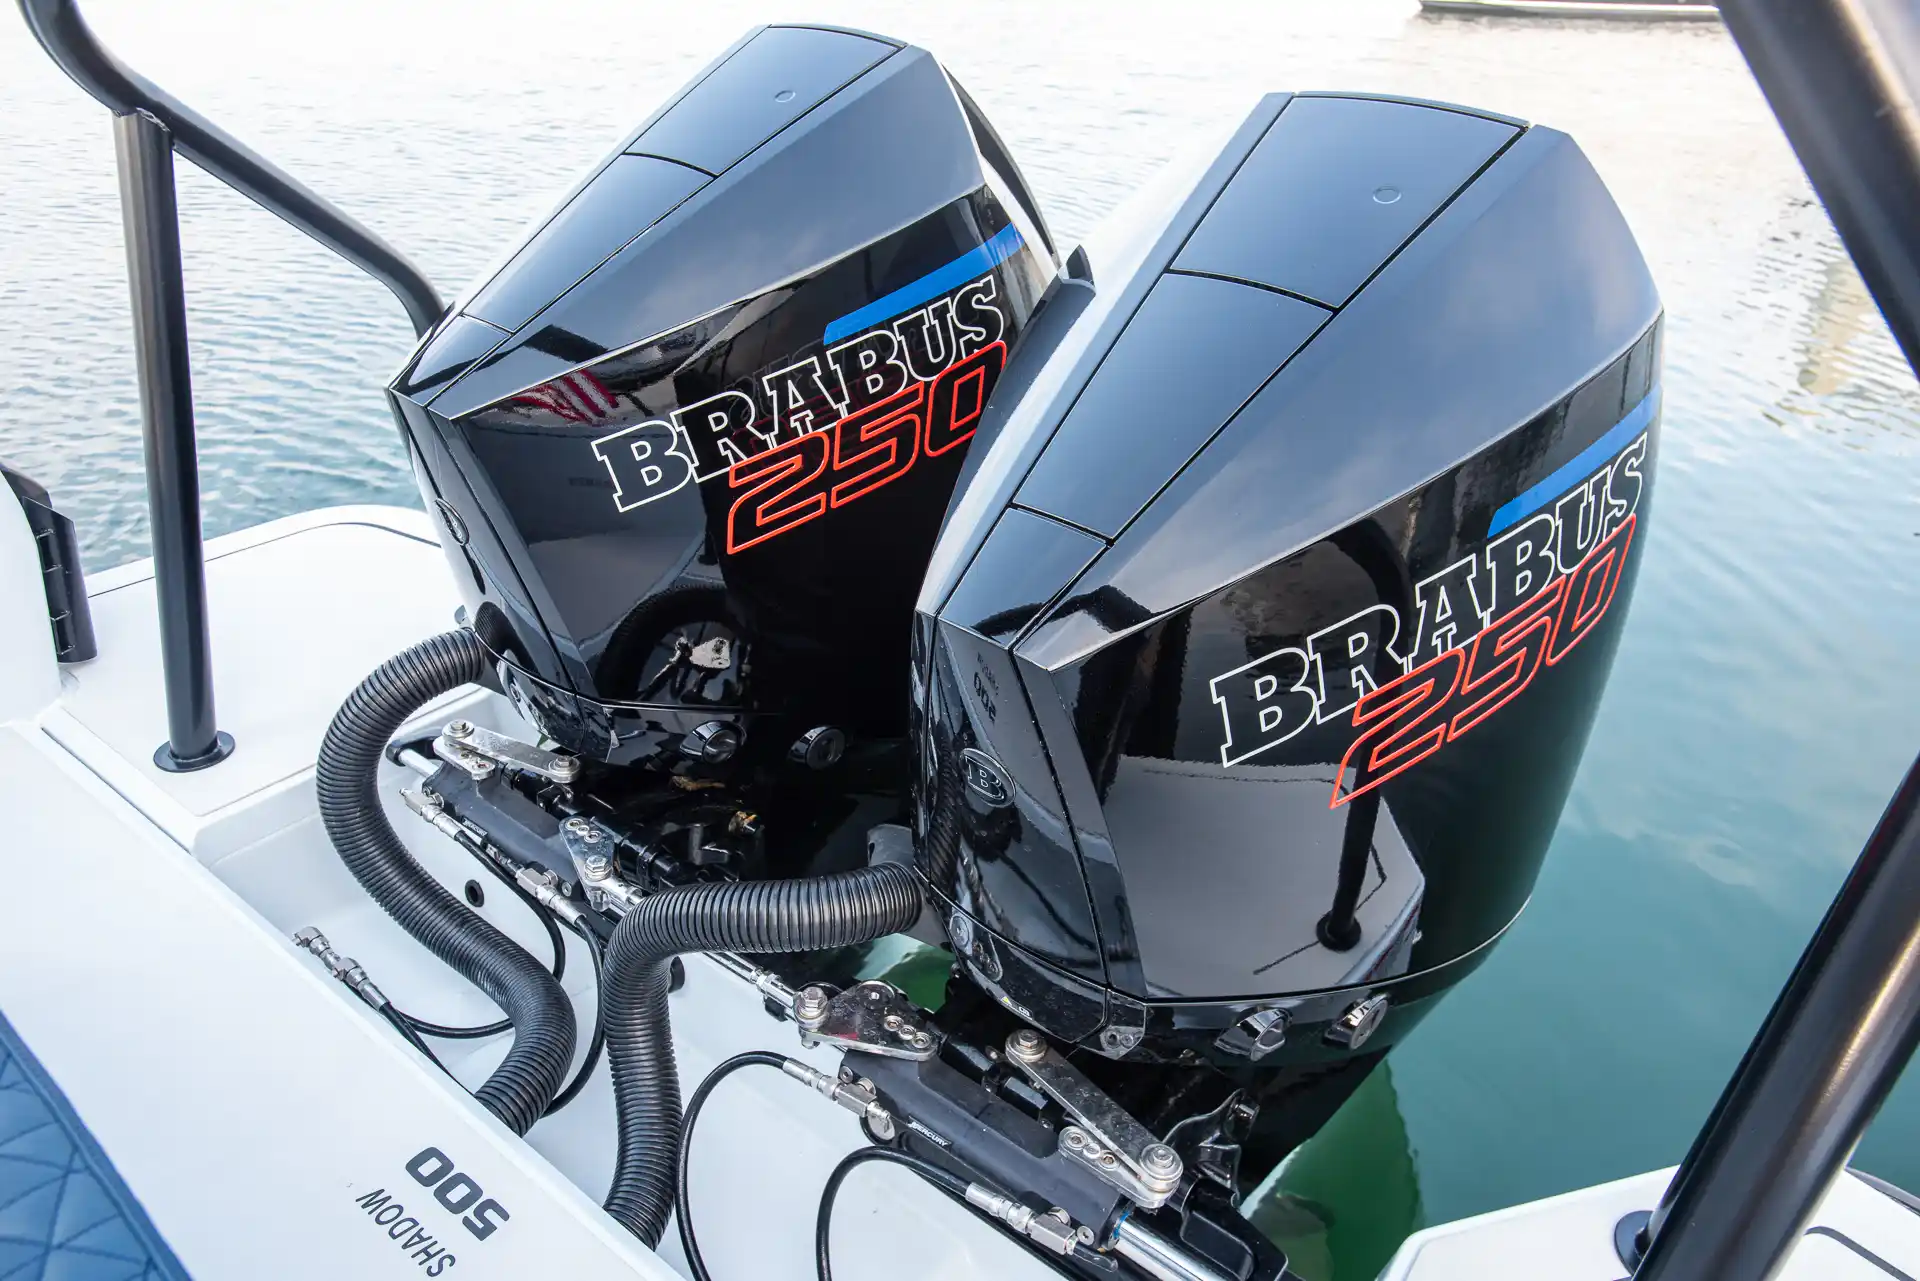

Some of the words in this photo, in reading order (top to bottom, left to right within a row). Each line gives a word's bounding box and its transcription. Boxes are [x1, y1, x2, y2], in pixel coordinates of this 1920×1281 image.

[591, 275, 1004, 513] BRABUS
[727, 340, 1007, 555] 250
[1209, 432, 1648, 768] BRABUS
[1330, 513, 1637, 810] 250
[355, 1188, 456, 1277] SHADOW
[405, 1146, 510, 1241] 500
[907, 1121, 949, 1147] MERCURY
